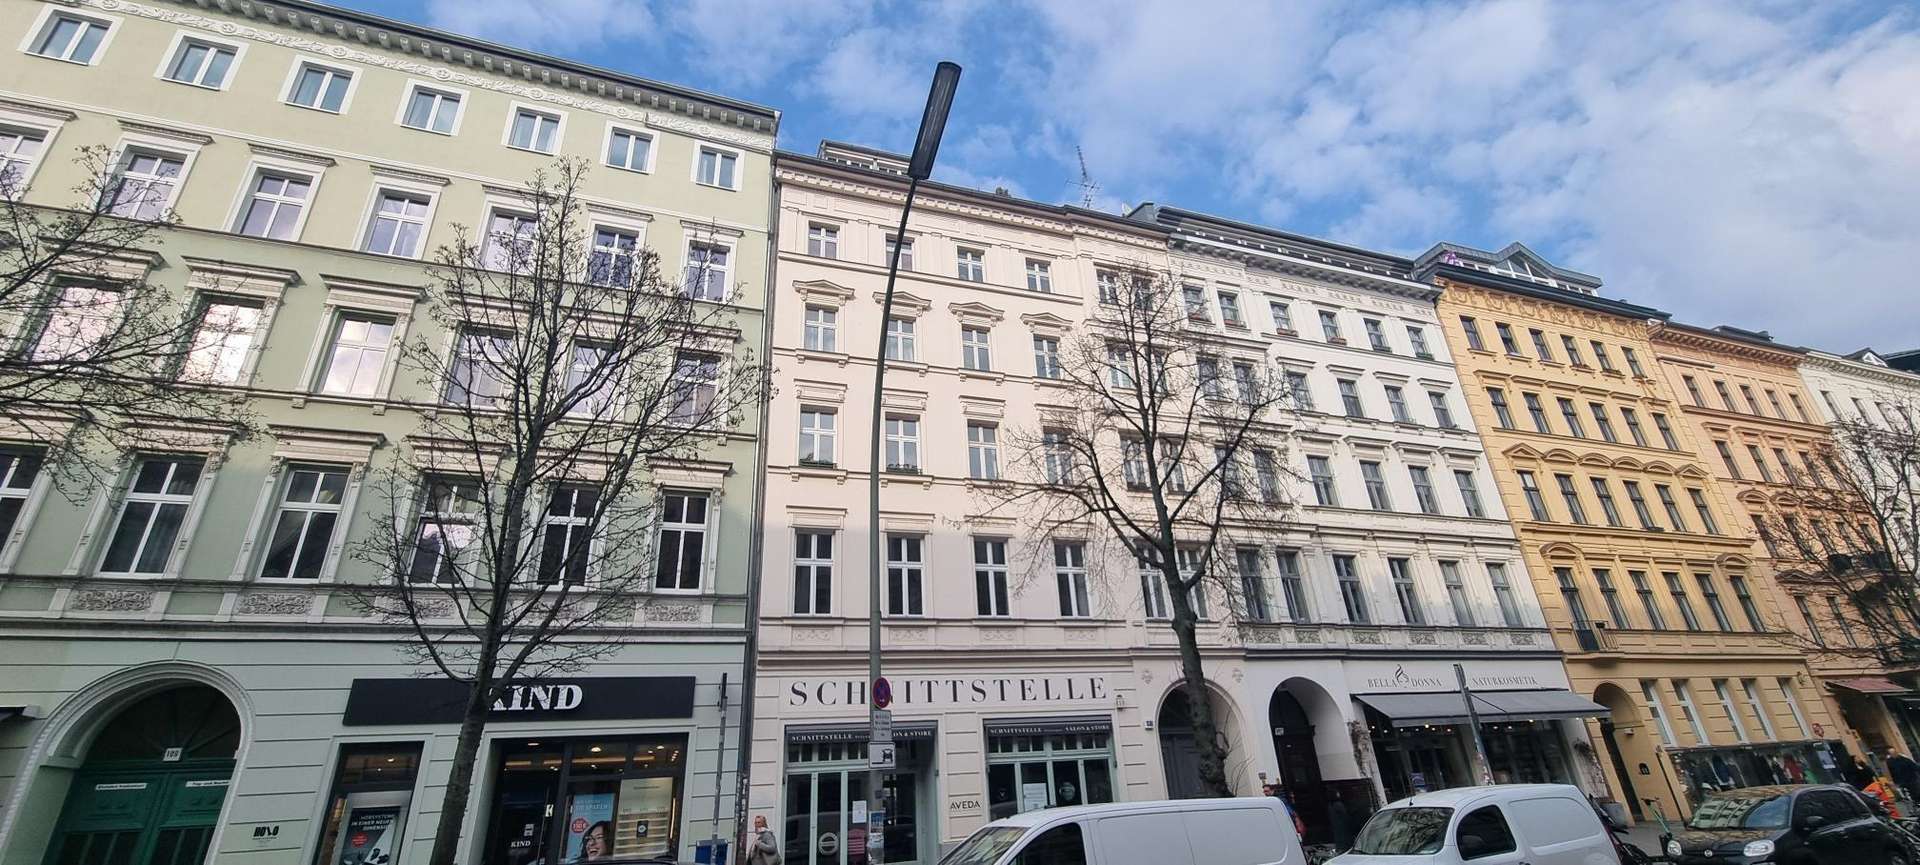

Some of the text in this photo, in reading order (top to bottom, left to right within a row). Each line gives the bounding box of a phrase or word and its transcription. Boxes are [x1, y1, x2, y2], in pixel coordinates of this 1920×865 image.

[1367, 677, 1442, 688] BELLA DONNA
[1471, 675, 1538, 686] NATURKOSMETIK
[789, 677, 1107, 707] SCHITTSTELLE
[950, 800, 982, 810] AVEDA
